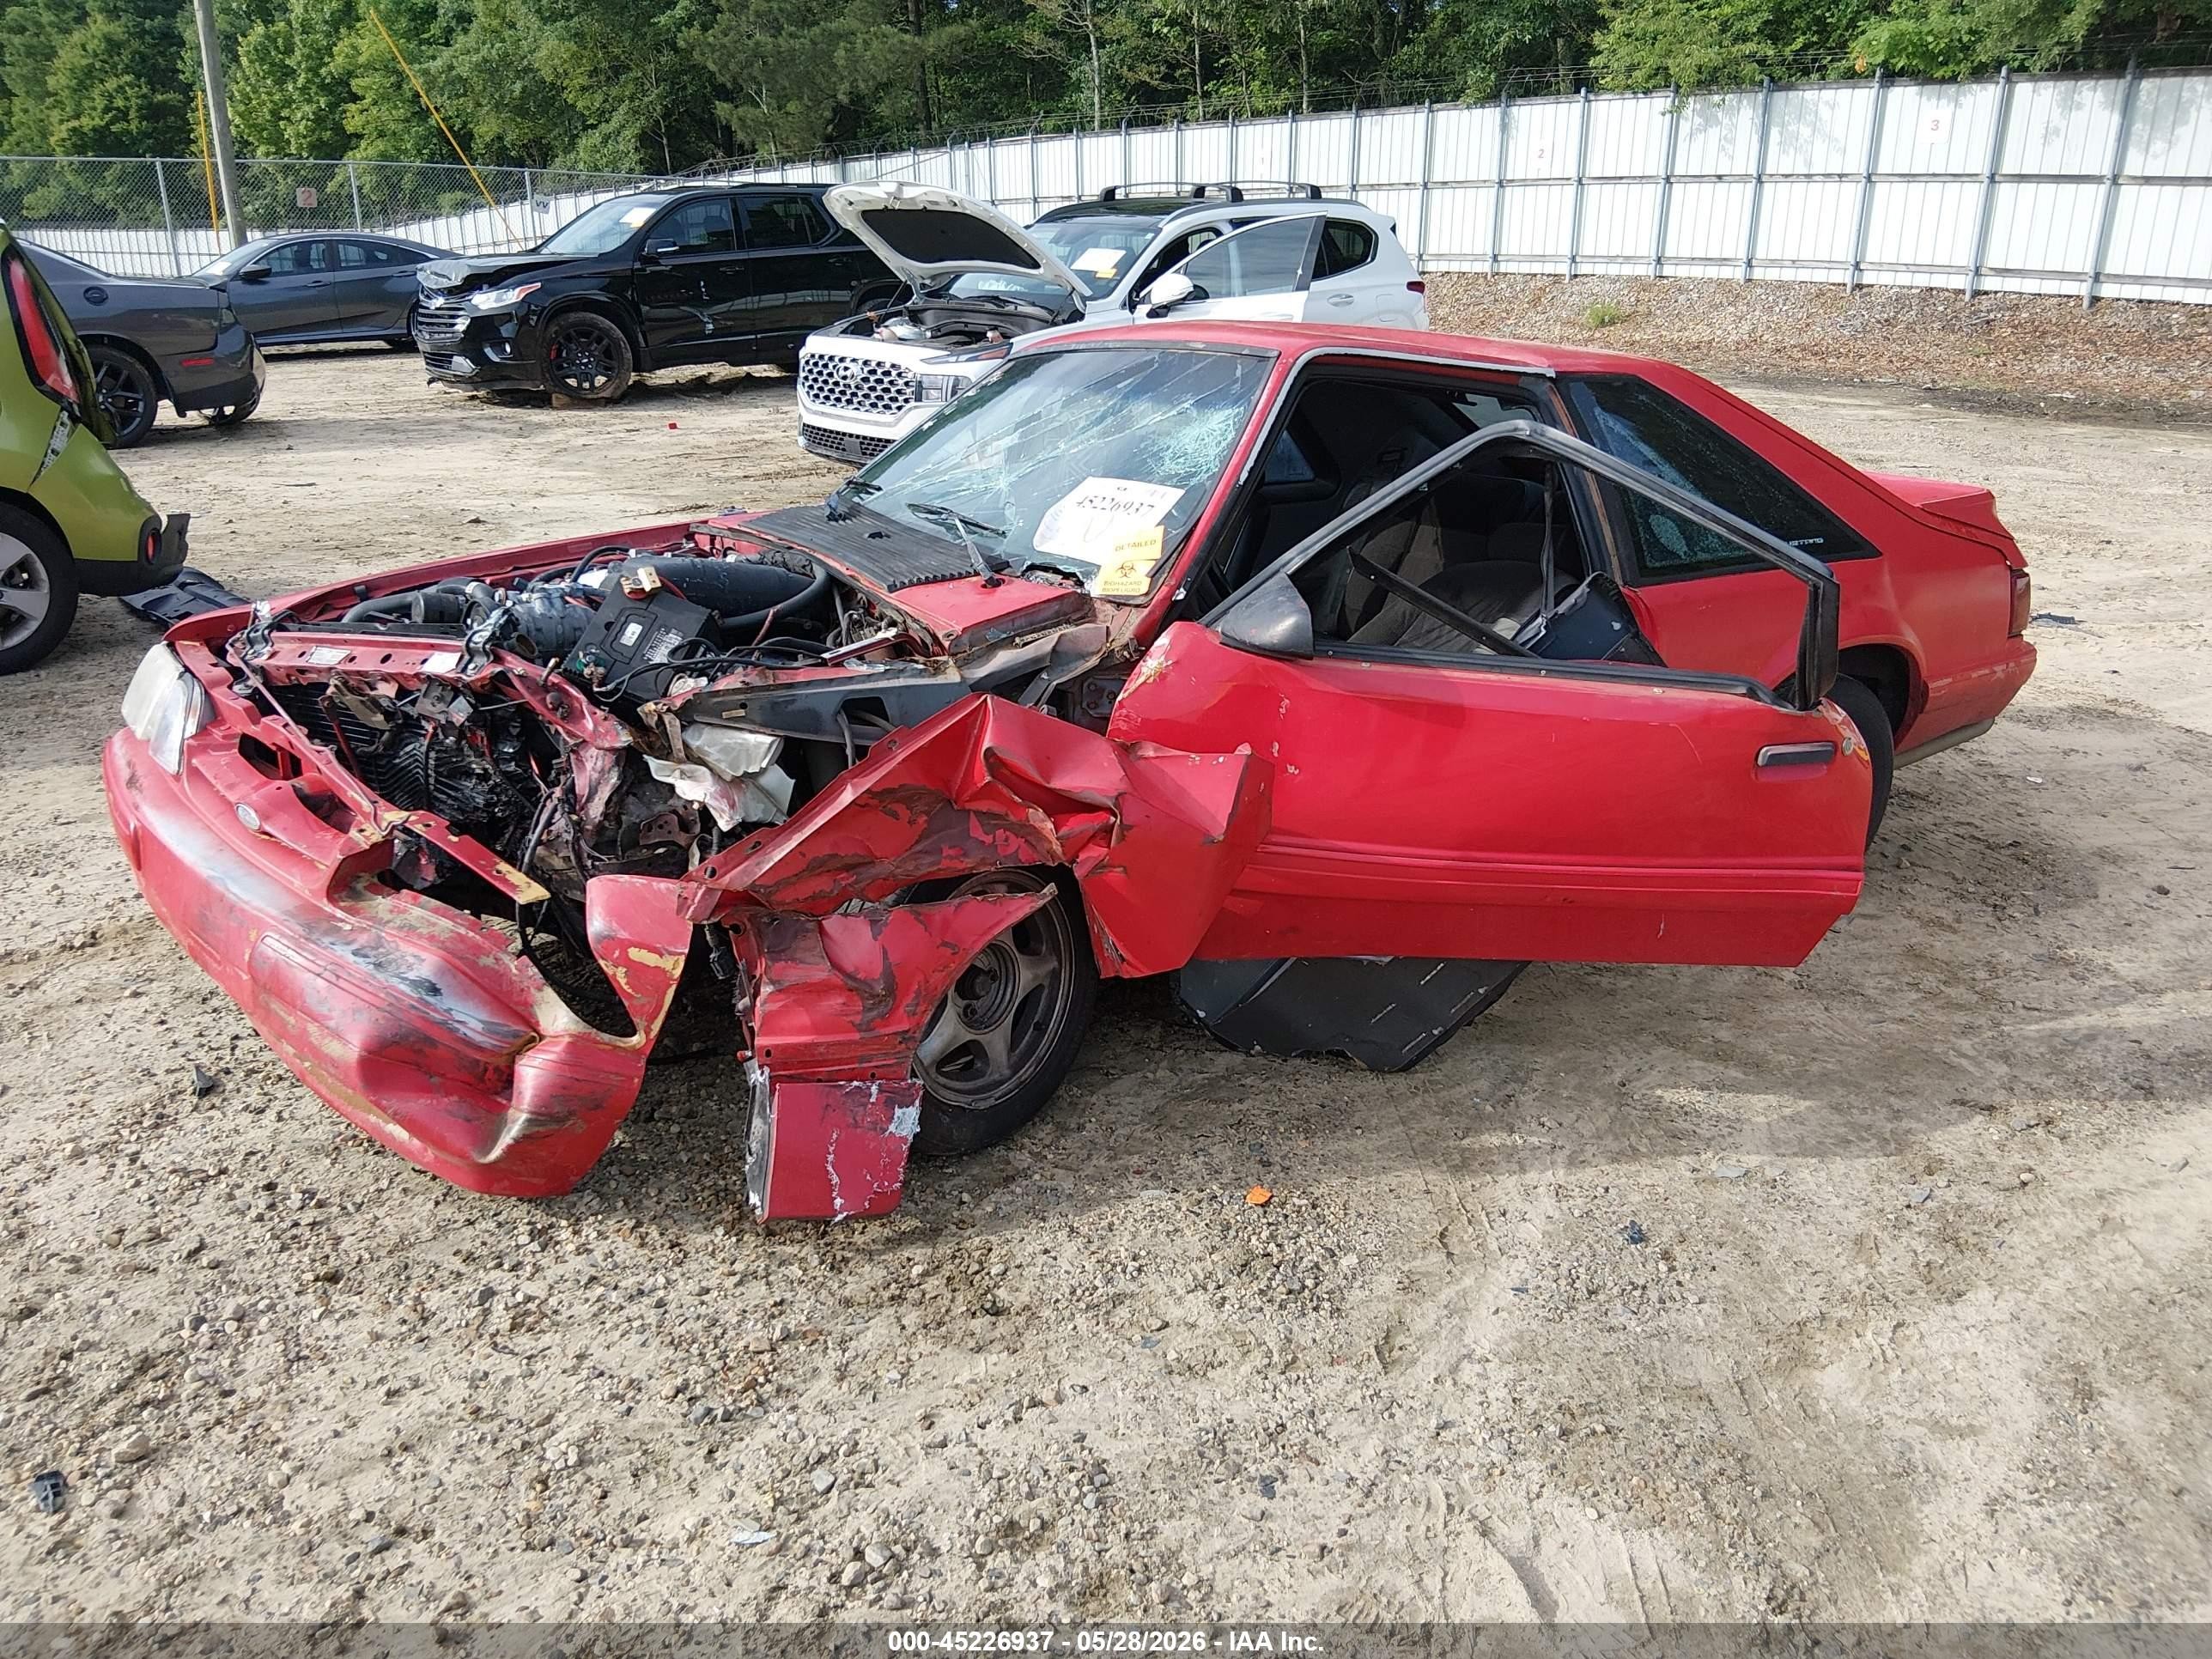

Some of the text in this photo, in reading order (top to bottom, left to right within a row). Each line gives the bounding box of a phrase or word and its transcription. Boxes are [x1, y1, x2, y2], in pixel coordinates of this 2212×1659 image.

[1930, 118, 1940, 131] 3
[1538, 148, 1545, 159] 2
[301, 188, 313, 206] 2
[1075, 495, 1155, 517] 45226937
[1115, 538, 1157, 552] DETAILED
